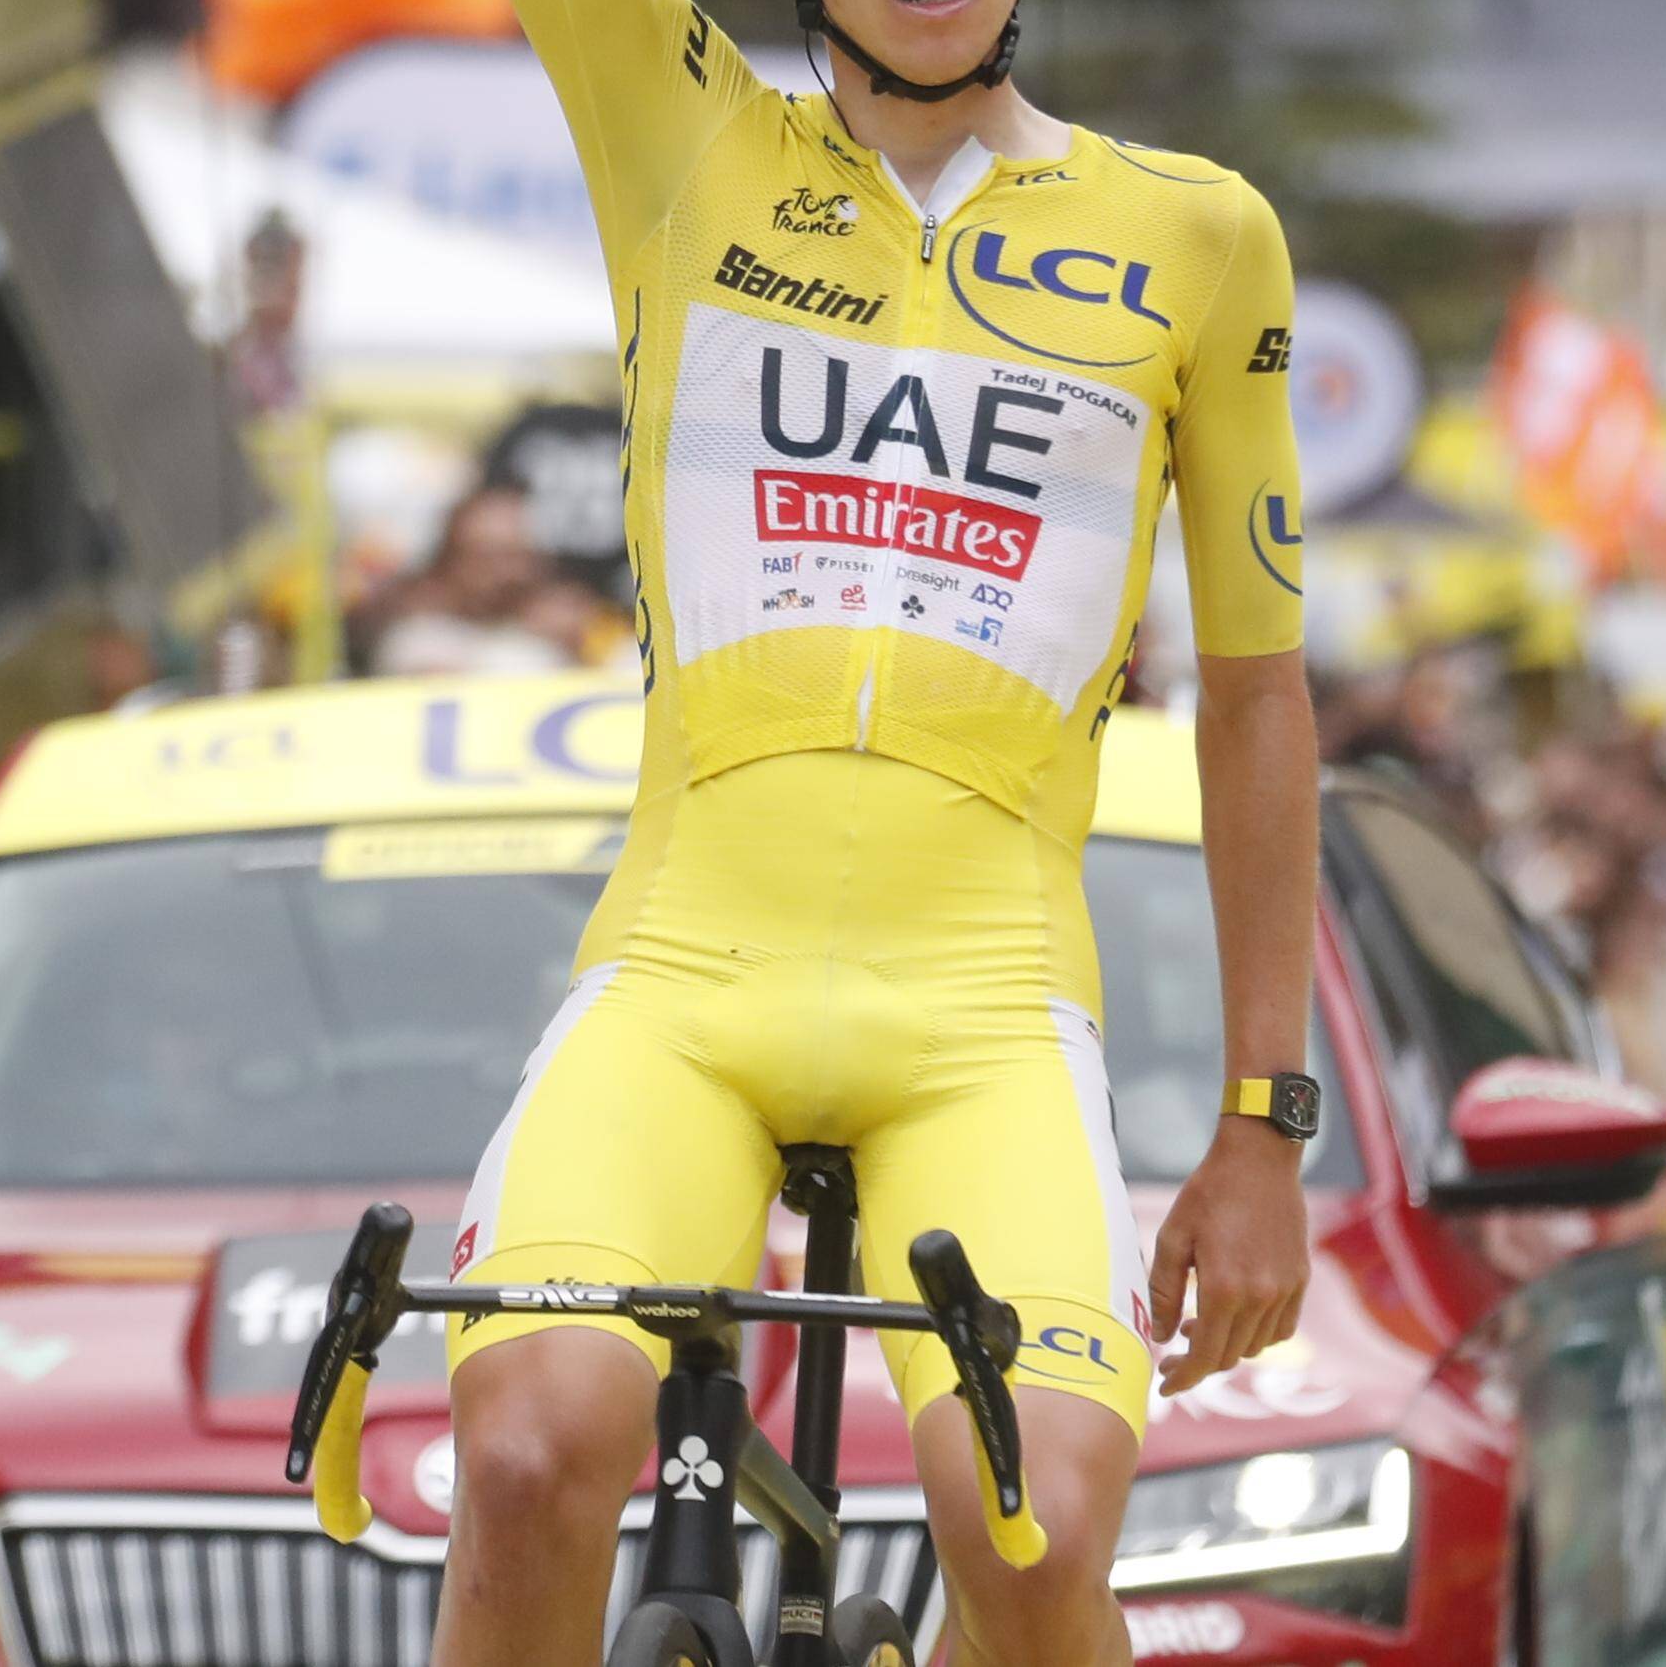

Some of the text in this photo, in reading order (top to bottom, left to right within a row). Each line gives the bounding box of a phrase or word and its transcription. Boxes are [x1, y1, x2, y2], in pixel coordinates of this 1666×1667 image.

[1015, 170, 1078, 185] LCL
[714, 243, 889, 325] Santini
[973, 231, 1172, 331] LCL
[760, 346, 1066, 501] UAE
[991, 368, 1138, 430] Tadej POGACAR
[761, 479, 1027, 569] Emirates
[763, 556, 793, 574] FAB
[896, 566, 962, 593] presight
[969, 582, 1014, 613] ADQ
[423, 698, 645, 784] LC
[632, 1301, 702, 1320] wahoo
